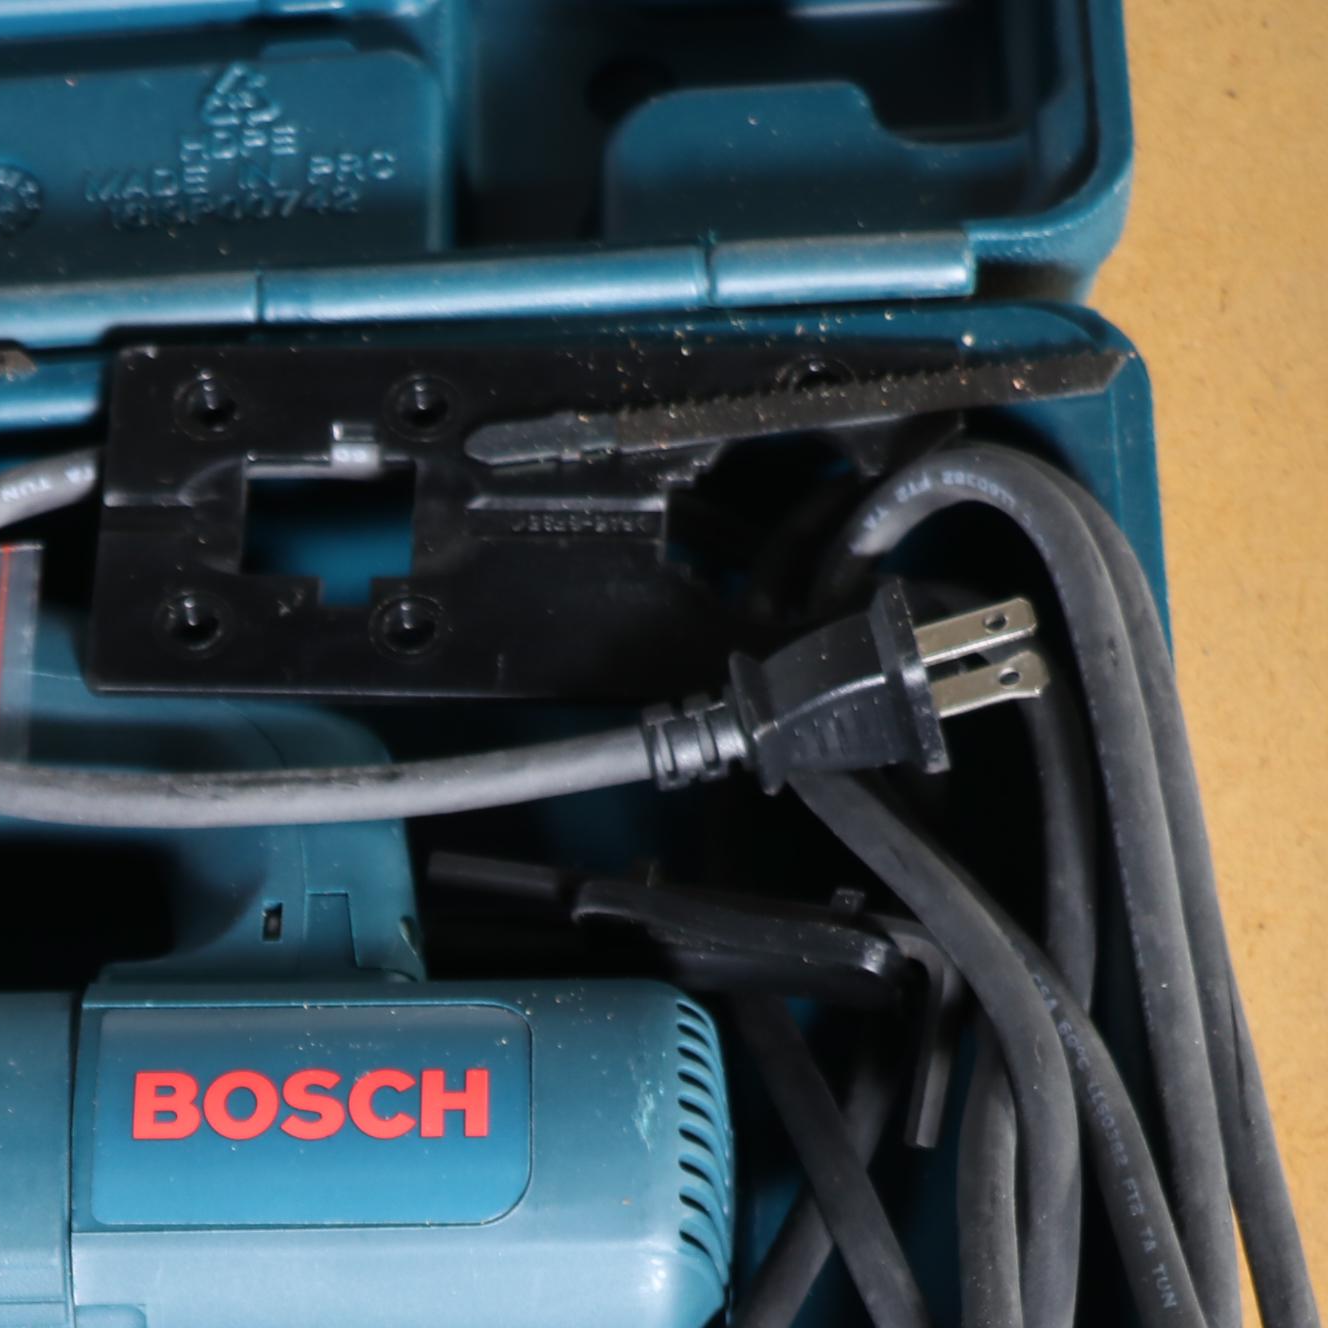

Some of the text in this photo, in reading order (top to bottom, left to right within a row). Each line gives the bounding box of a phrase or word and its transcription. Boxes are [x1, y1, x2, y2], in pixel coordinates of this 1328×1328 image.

[82, 164, 210, 203] MADE
[307, 149, 397, 185] PRC
[1, 477, 52, 503] TUN
[132, 1068, 491, 1141] BOSCH
[1136, 1226, 1160, 1254] TA
[1151, 1262, 1179, 1308] TUN
